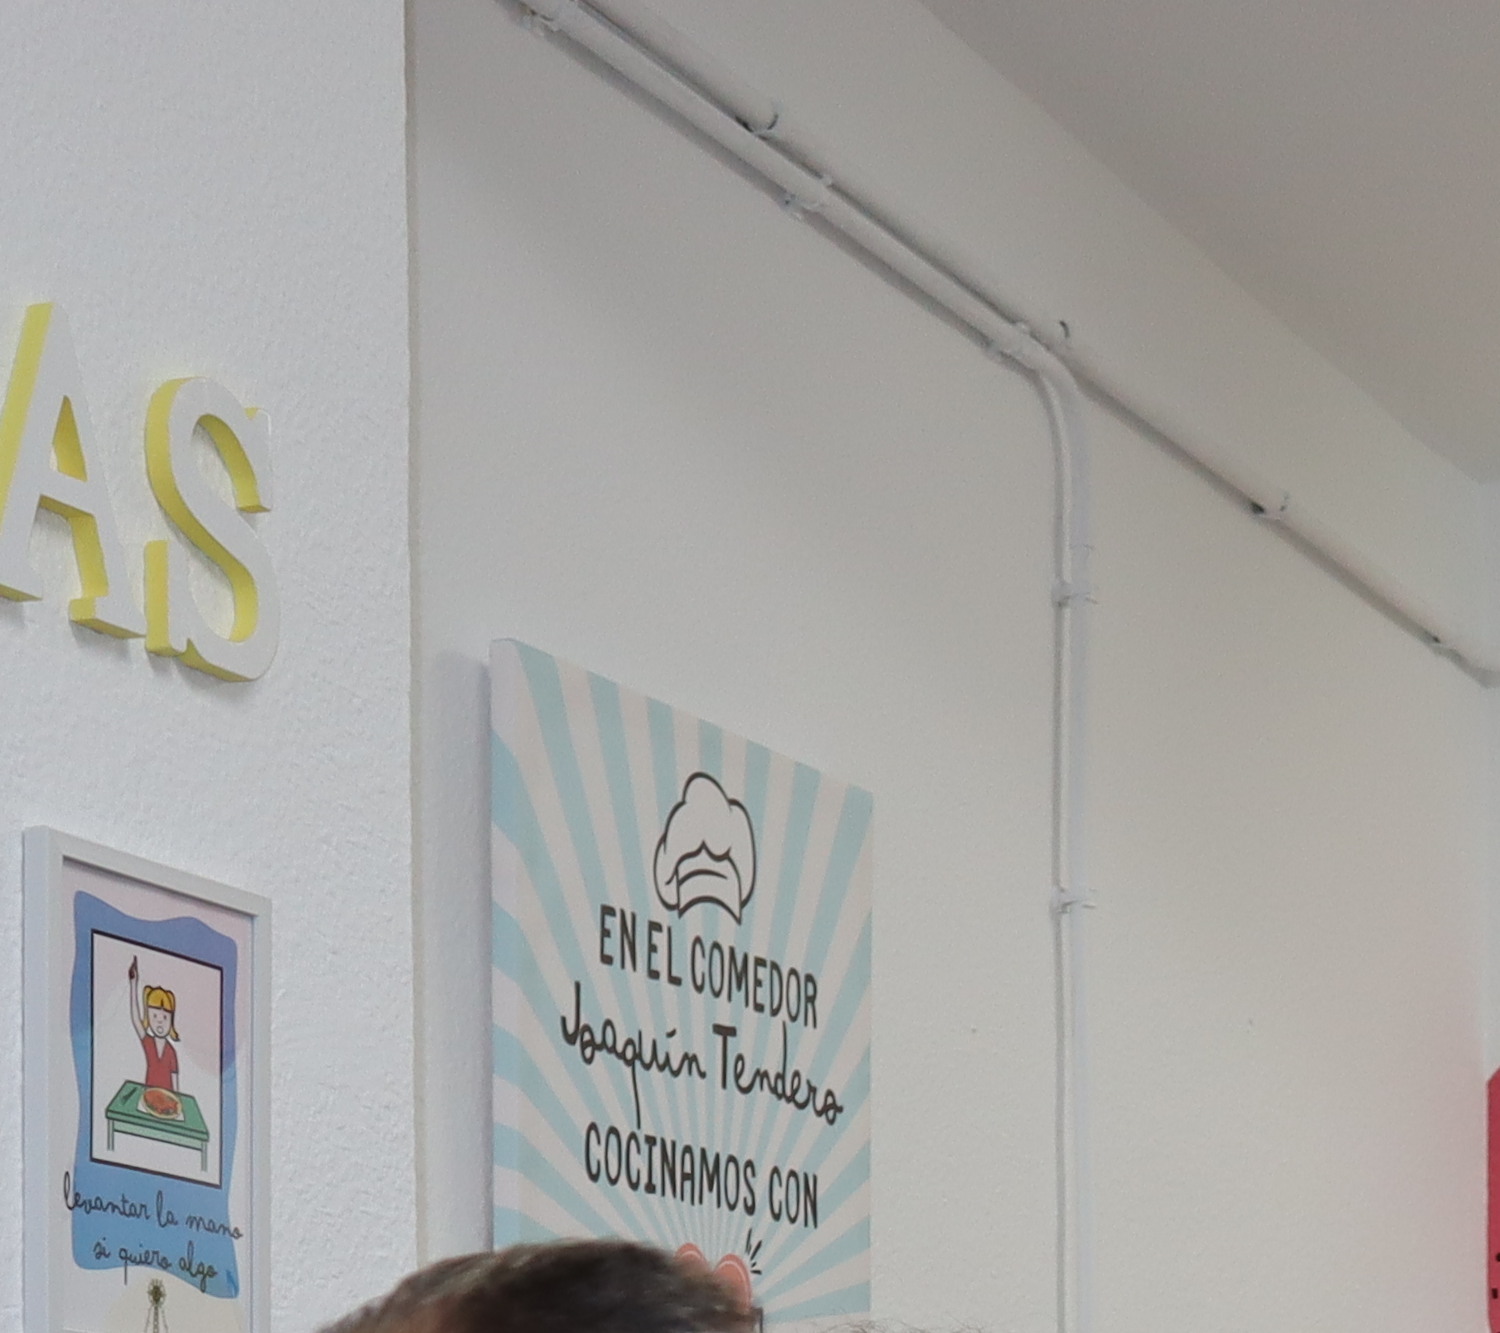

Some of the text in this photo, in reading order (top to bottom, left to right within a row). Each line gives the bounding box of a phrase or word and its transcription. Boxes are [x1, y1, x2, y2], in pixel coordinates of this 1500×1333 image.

[600, 904, 817, 1029] EN EL COMEDOR
[712, 1020, 843, 1125] Tendero
[63, 1171, 243, 1239] levantar la mano
[585, 1122, 818, 1228] COCINAMOS CON
[93, 1237, 218, 1293] si quiero algo
